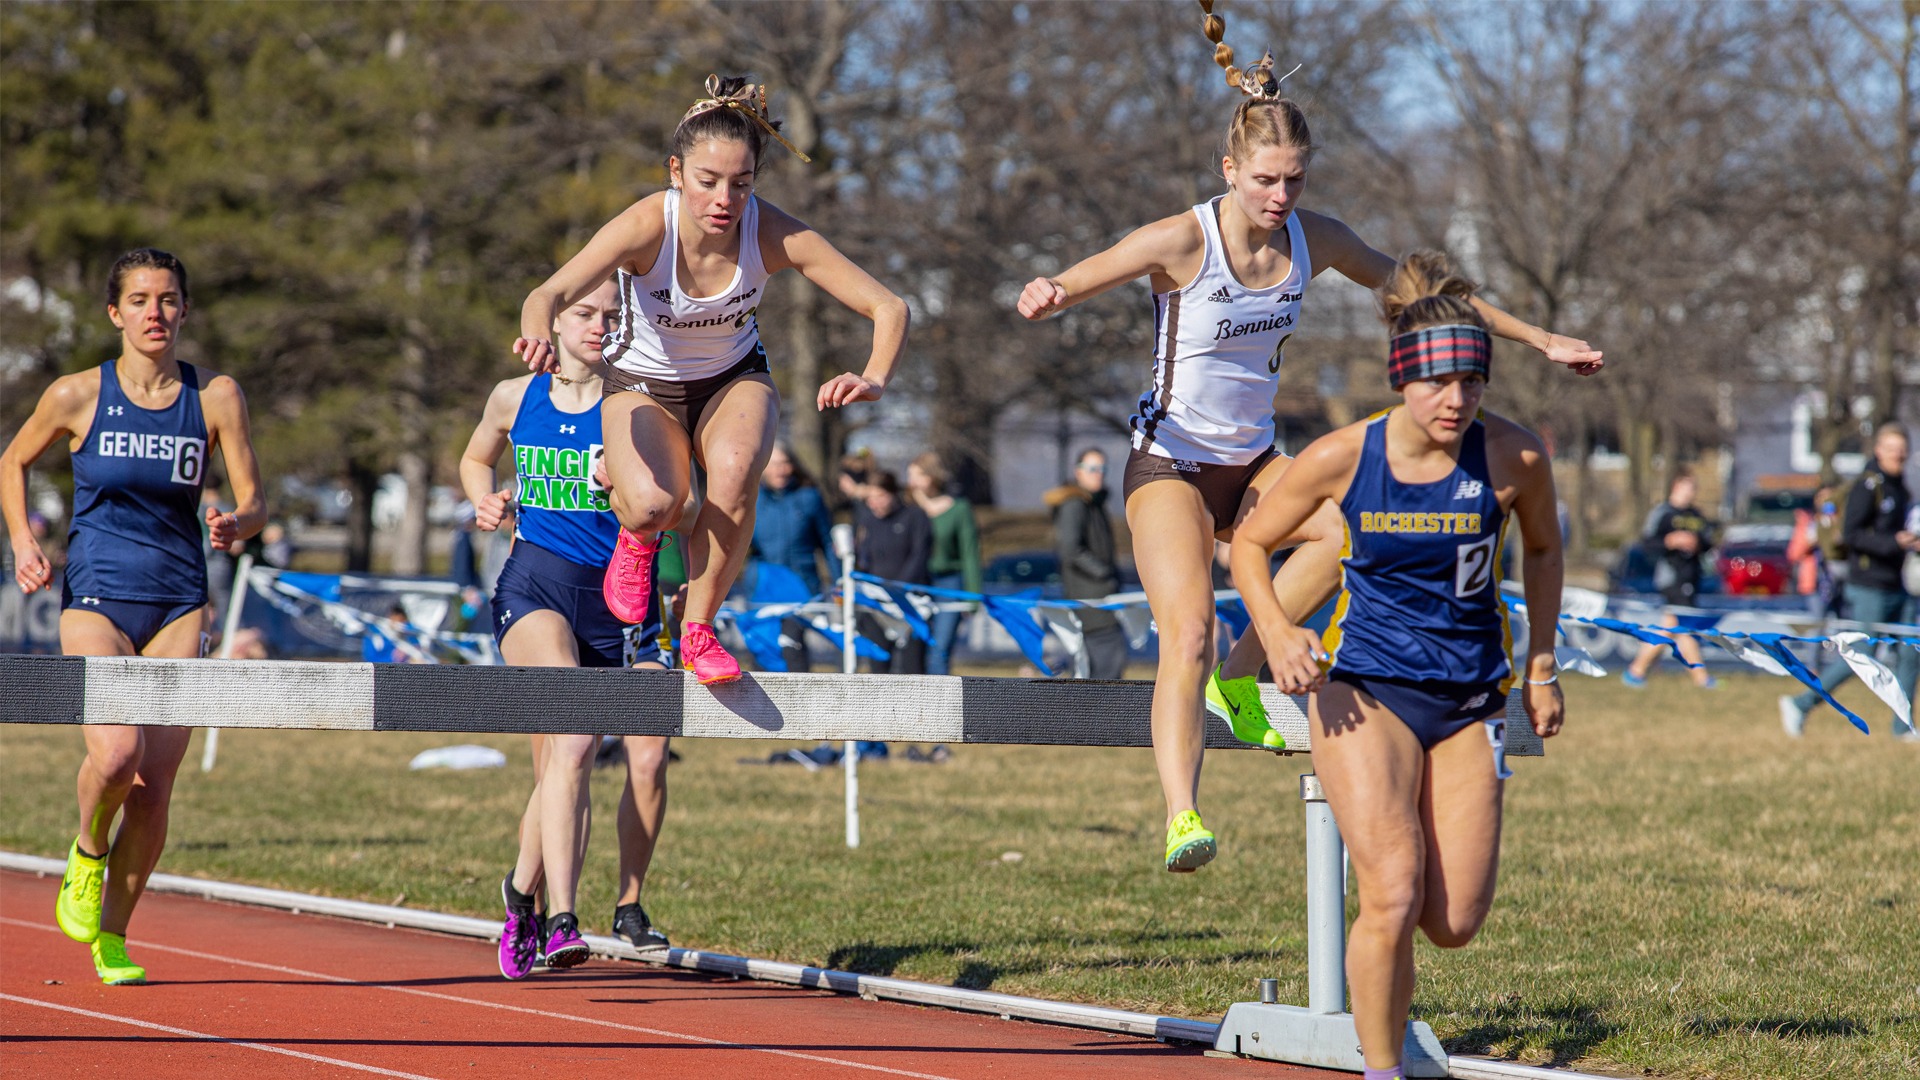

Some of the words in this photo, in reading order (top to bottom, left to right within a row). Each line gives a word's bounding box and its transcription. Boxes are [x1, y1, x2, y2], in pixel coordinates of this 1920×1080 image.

[1208, 295, 1234, 304] adidas
[1213, 312, 1294, 341] Bonnies
[98, 431, 175, 461] GENES
[178, 441, 200, 481] 6
[1171, 463, 1201, 473] adidas
[1359, 511, 1482, 535] ROCHESTER
[1463, 543, 1490, 593] 2
